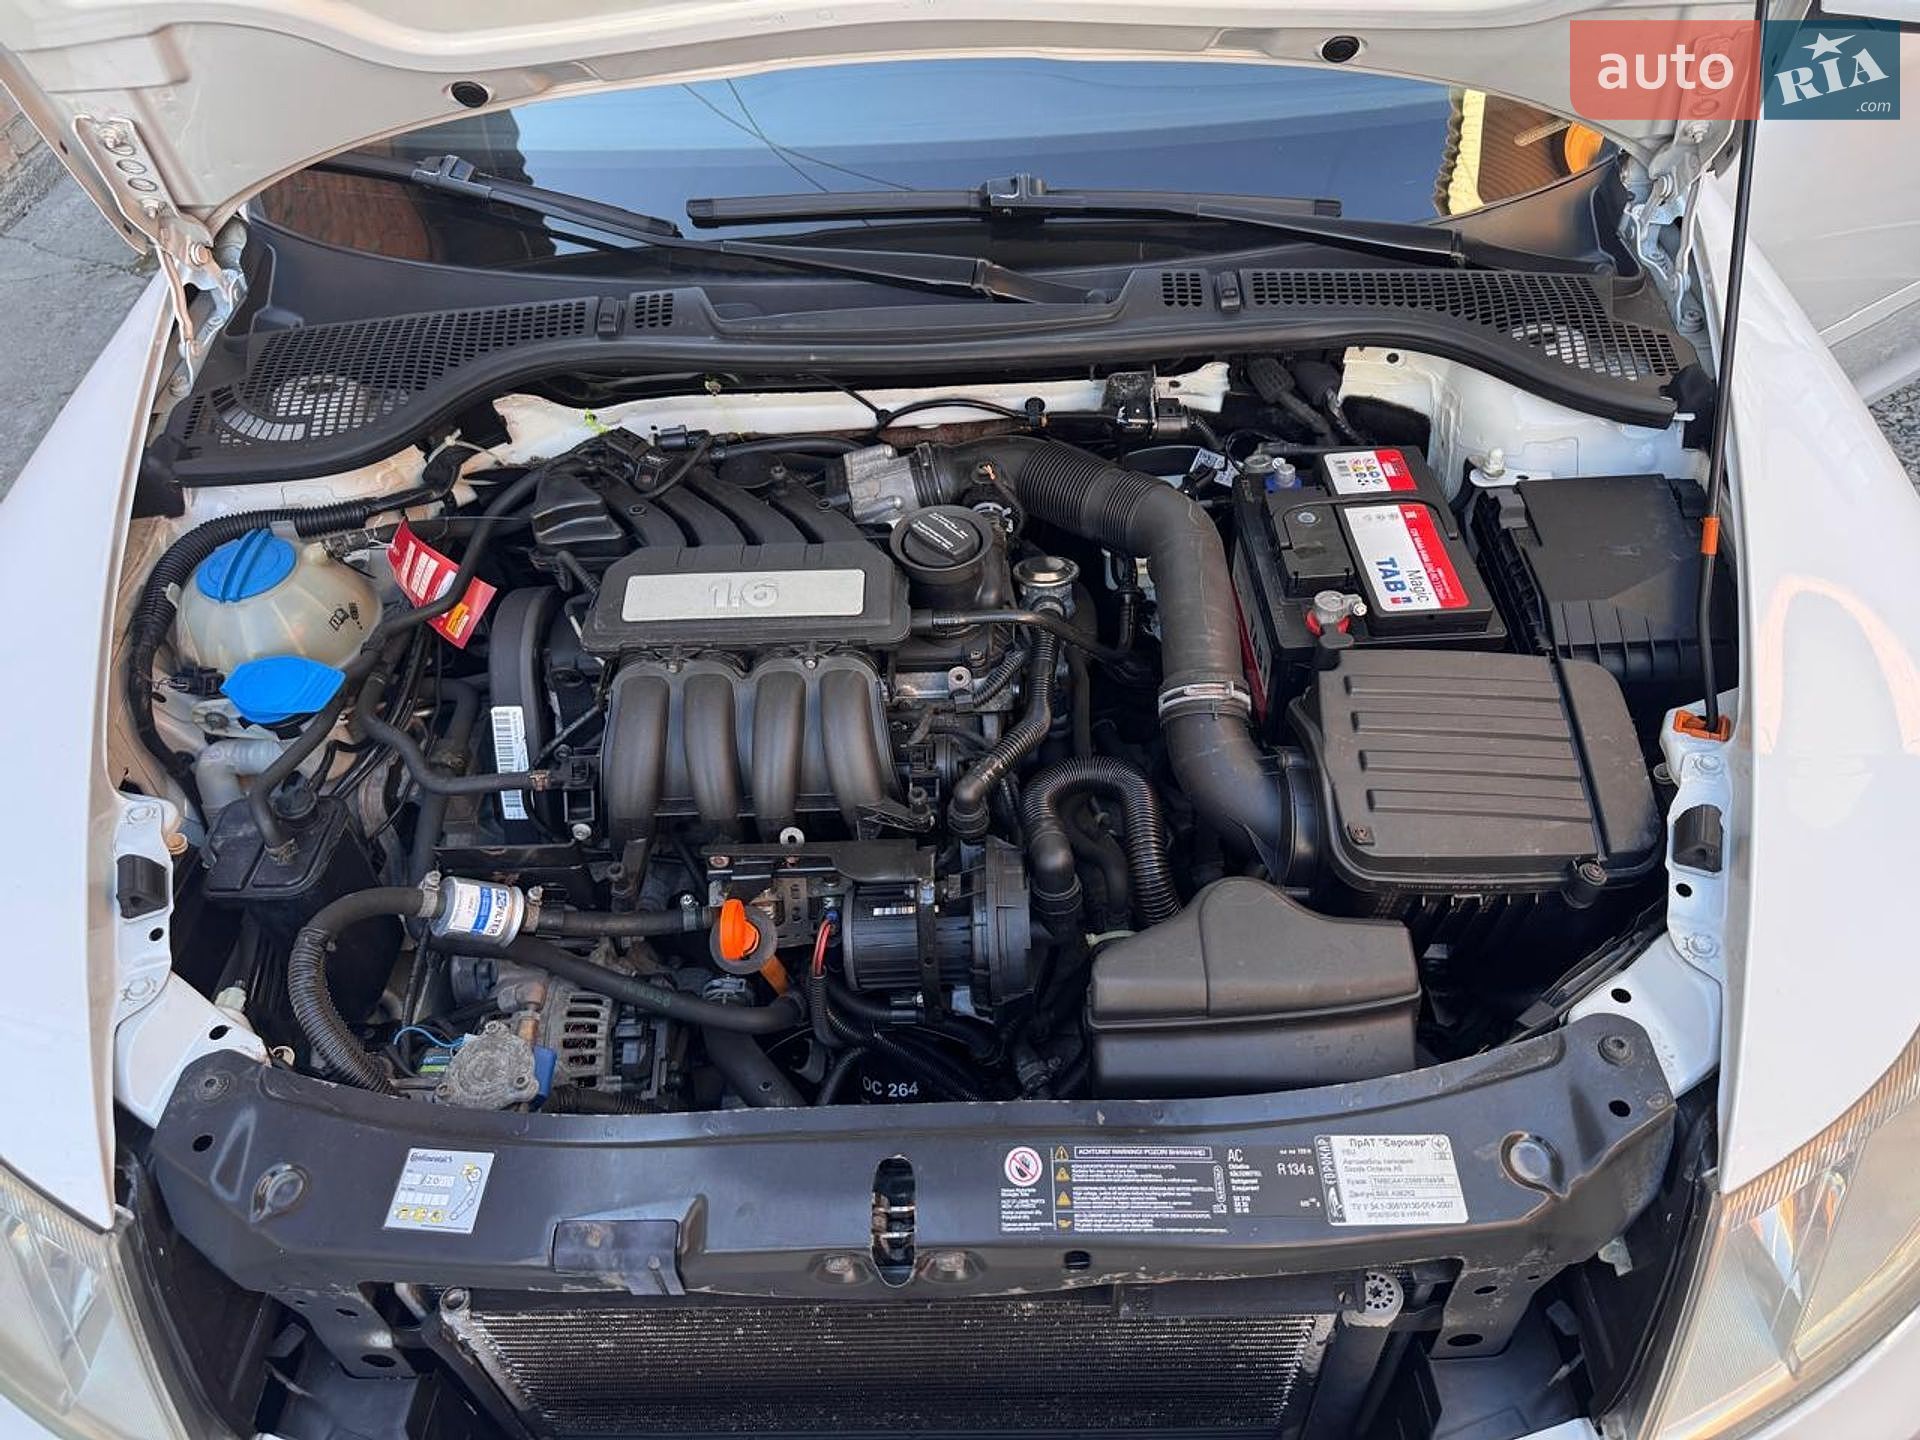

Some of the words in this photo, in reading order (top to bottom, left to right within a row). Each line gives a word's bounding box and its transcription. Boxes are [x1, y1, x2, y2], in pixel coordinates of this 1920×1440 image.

[1375, 556, 1407, 594] TAB
[1406, 569, 1433, 604] Magic
[862, 1076, 883, 1096] OC
[887, 1081, 919, 1098] 264
[1228, 1148, 1243, 1162] AC
[1277, 1162, 1287, 1175] R
[1288, 1162, 1306, 1176] 134
